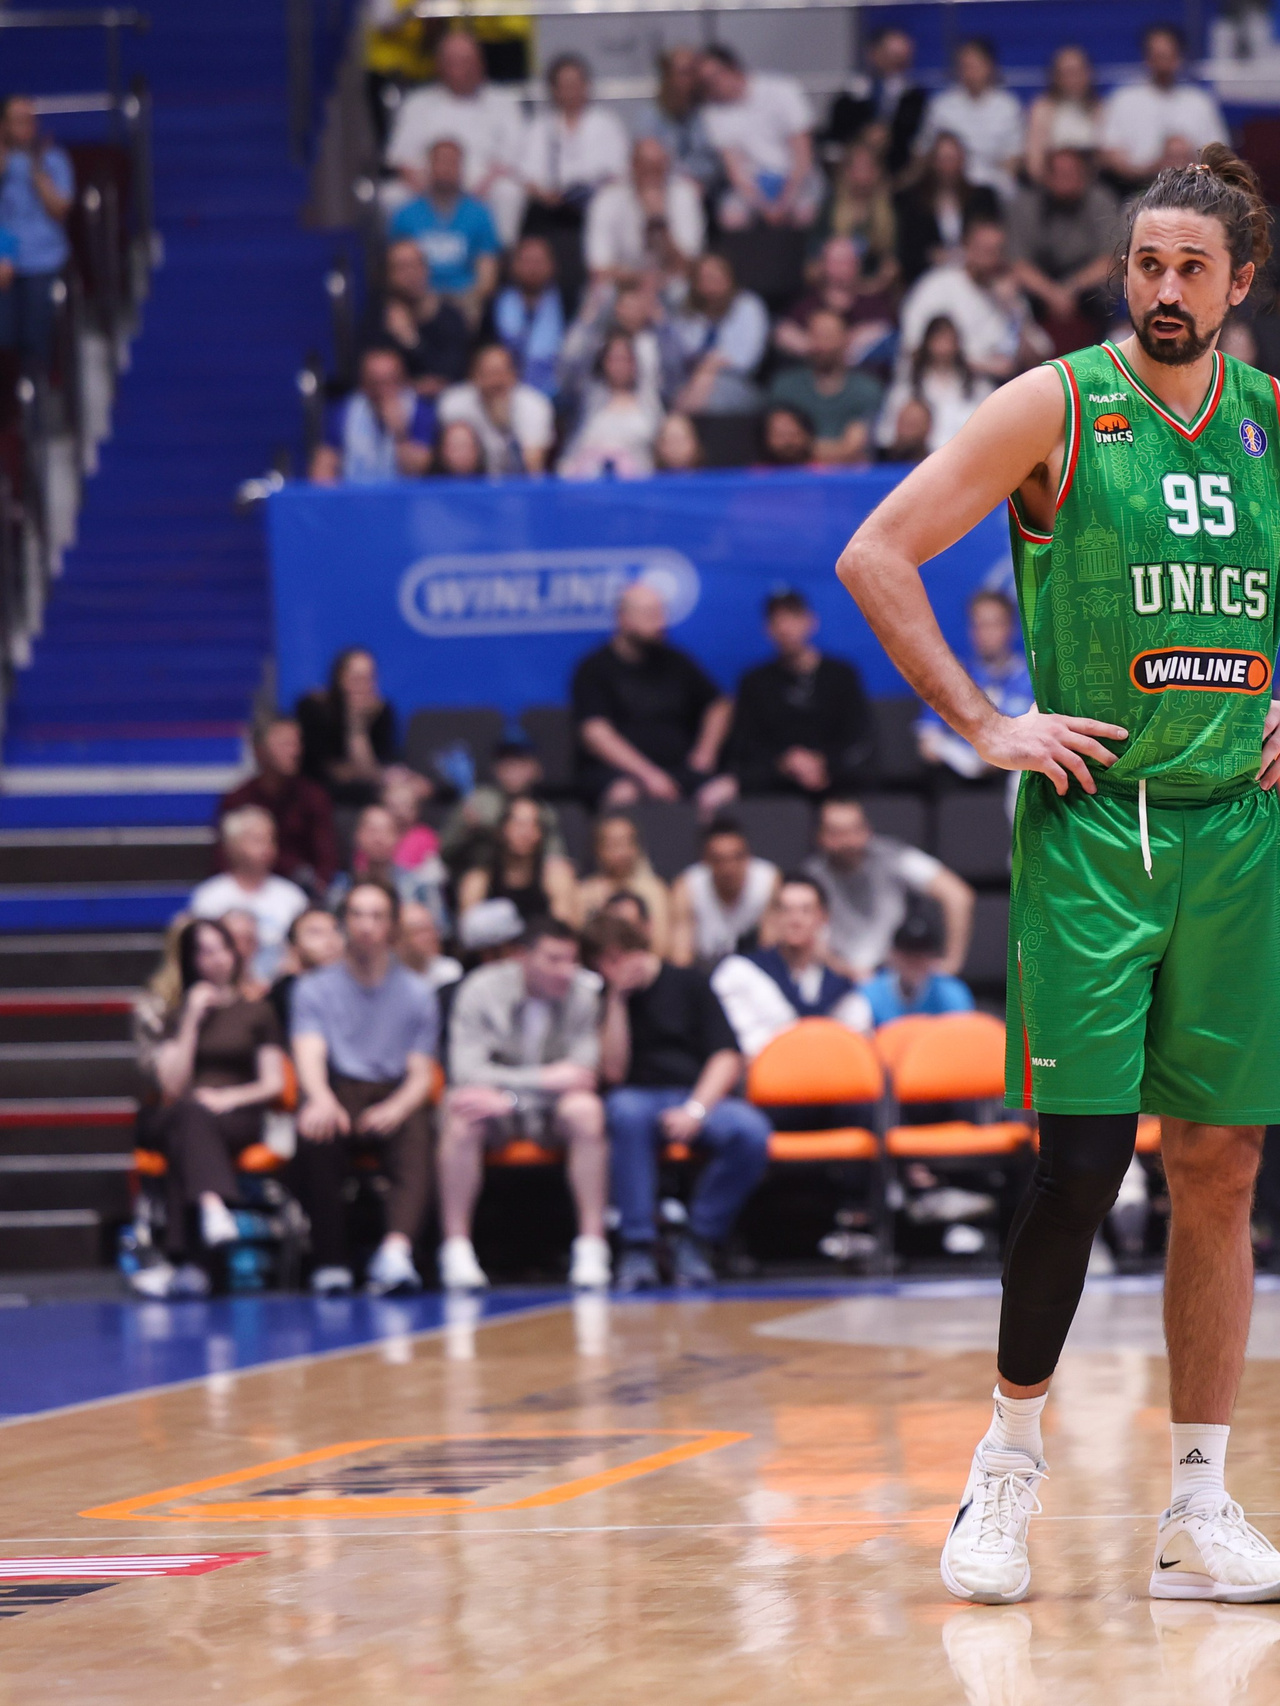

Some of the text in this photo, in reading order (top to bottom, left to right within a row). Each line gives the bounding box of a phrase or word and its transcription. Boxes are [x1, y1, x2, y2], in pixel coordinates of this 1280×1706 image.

[1088, 392, 1128, 403] MAXX
[1094, 429, 1134, 443] UNICS
[1161, 472, 1238, 538] 95
[1130, 563, 1269, 620] UNICS
[1144, 656, 1248, 684] WINLINE
[1031, 1057, 1057, 1067] MAXX
